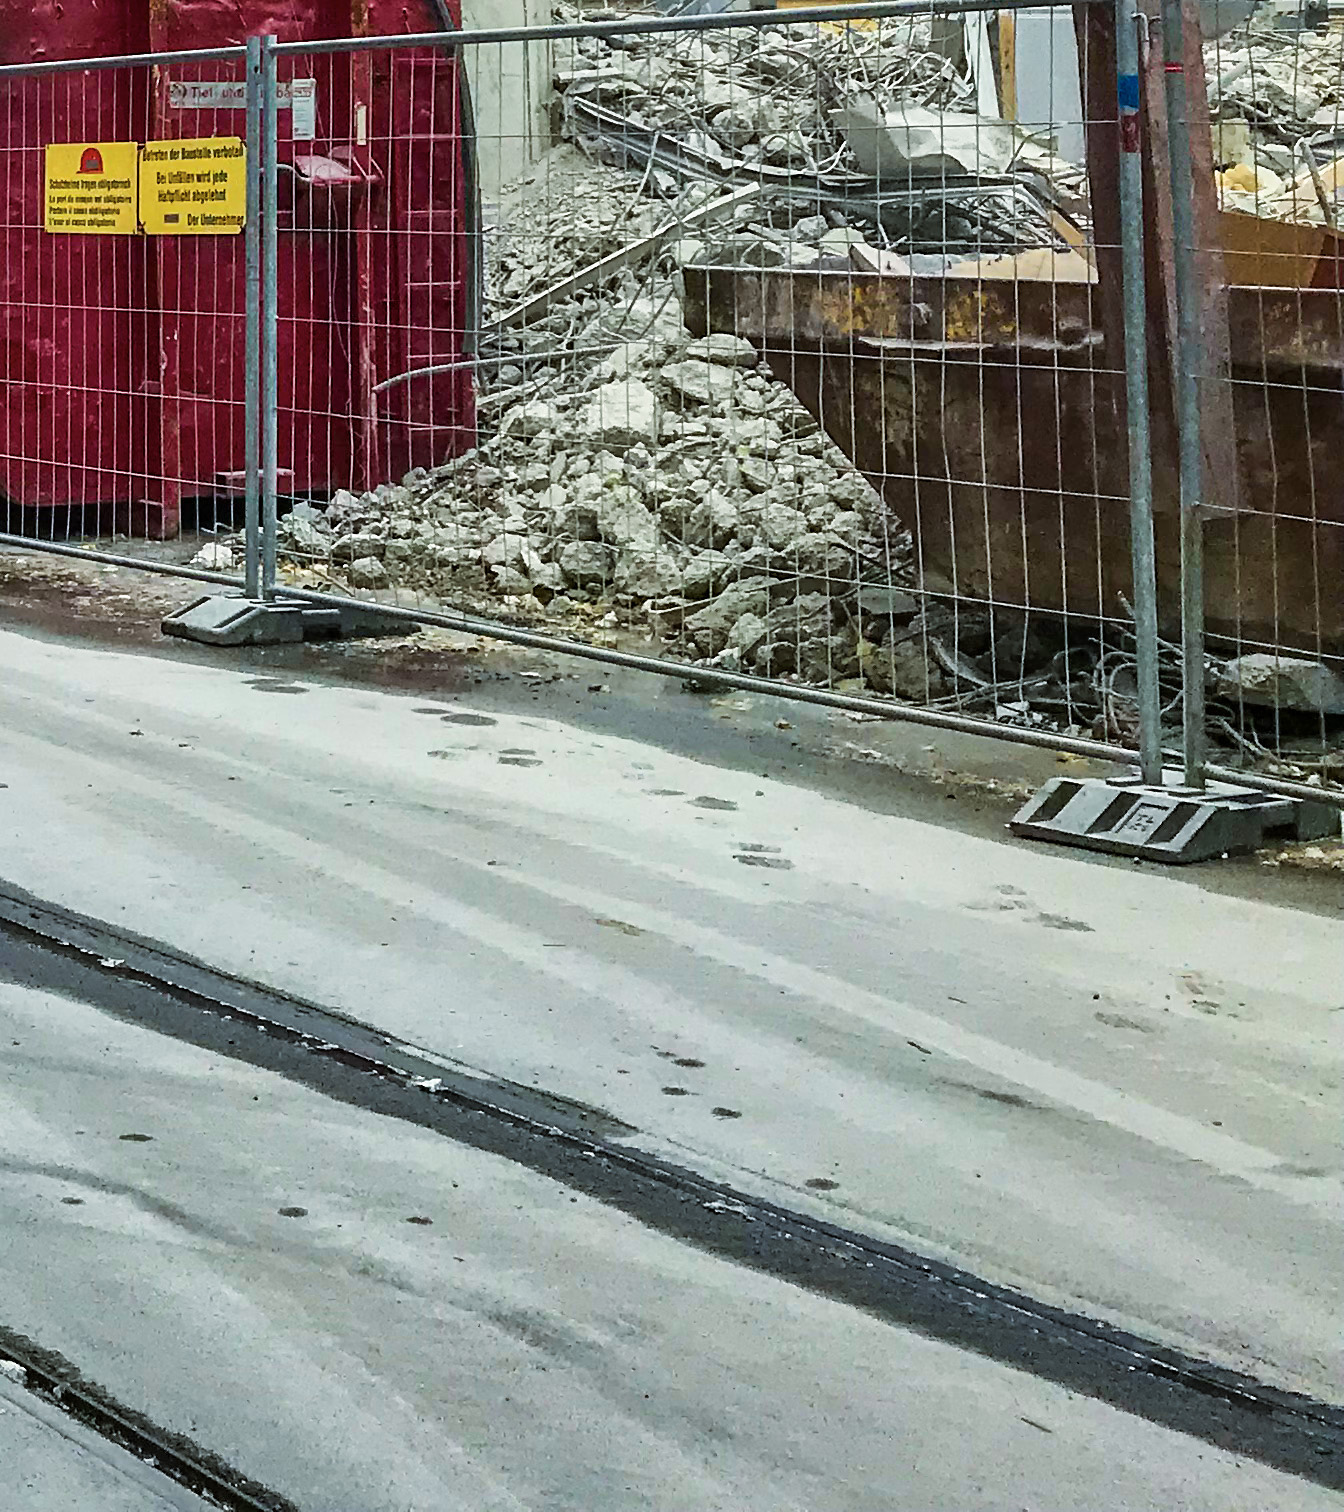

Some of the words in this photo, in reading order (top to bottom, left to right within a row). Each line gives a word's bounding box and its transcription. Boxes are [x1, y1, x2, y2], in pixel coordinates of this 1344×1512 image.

[143, 148, 168, 161] Betreten
[170, 149, 180, 160] der
[182, 147, 211, 160] Baustelle
[213, 145, 243, 159] verboten
[157, 171, 166, 184] Bei
[168, 171, 194, 184] Unfällen
[196, 170, 210, 183] wird
[213, 170, 228, 185] jede
[158, 189, 190, 203] Haftpflicht
[193, 189, 226, 204] abgelehnt
[188, 214, 199, 225] Der
[201, 214, 244, 226] Unternehmer
